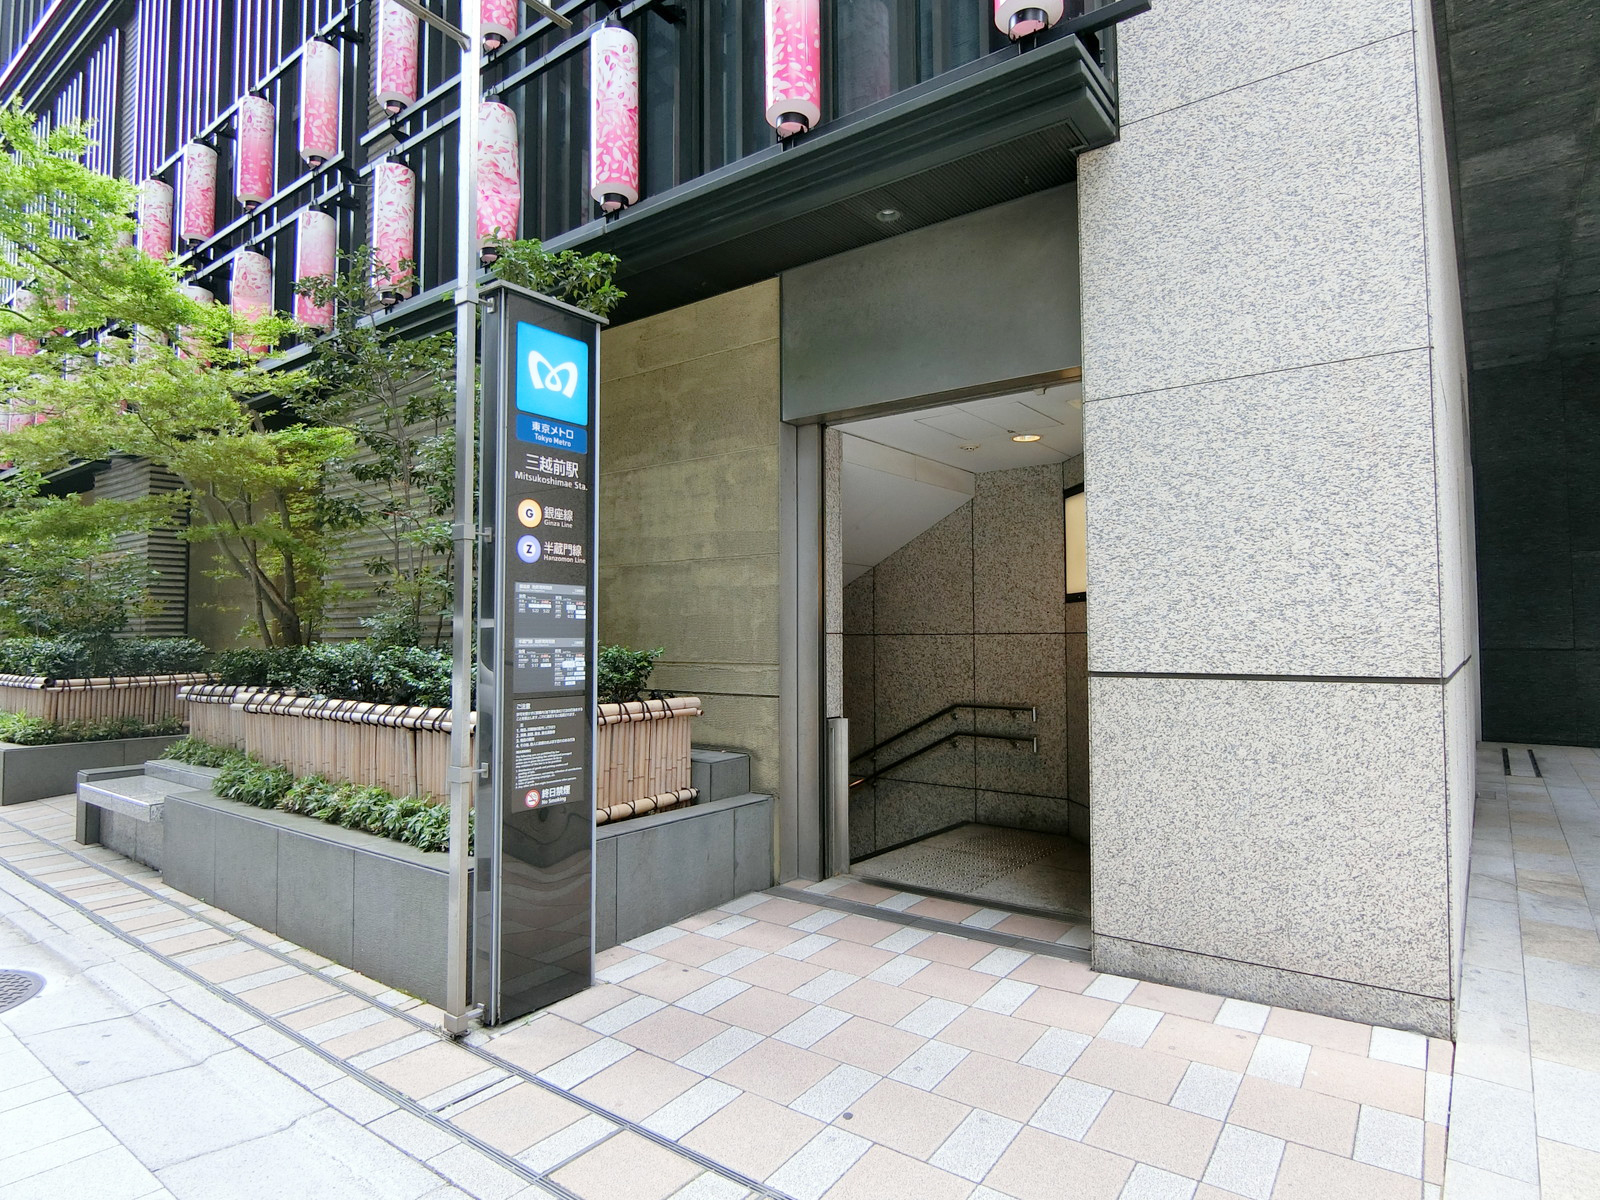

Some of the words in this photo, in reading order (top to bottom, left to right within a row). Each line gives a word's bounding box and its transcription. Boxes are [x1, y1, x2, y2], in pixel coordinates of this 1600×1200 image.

[532, 421, 574, 439] 東京メトロ
[534, 433, 552, 444] Tokyo
[554, 437, 571, 447] Metro
[526, 453, 579, 479] 三越前駅
[515, 471, 572, 488] Mitsukoshimae
[574, 482, 588, 491] Sta.
[526, 508, 533, 518] G
[544, 506, 573, 521] 銀座線
[526, 544, 532, 554] Z
[544, 541, 582, 557] 半蔵門線
[544, 555, 573, 563] Hanzomon
[541, 785, 571, 799] 終日禁煙
